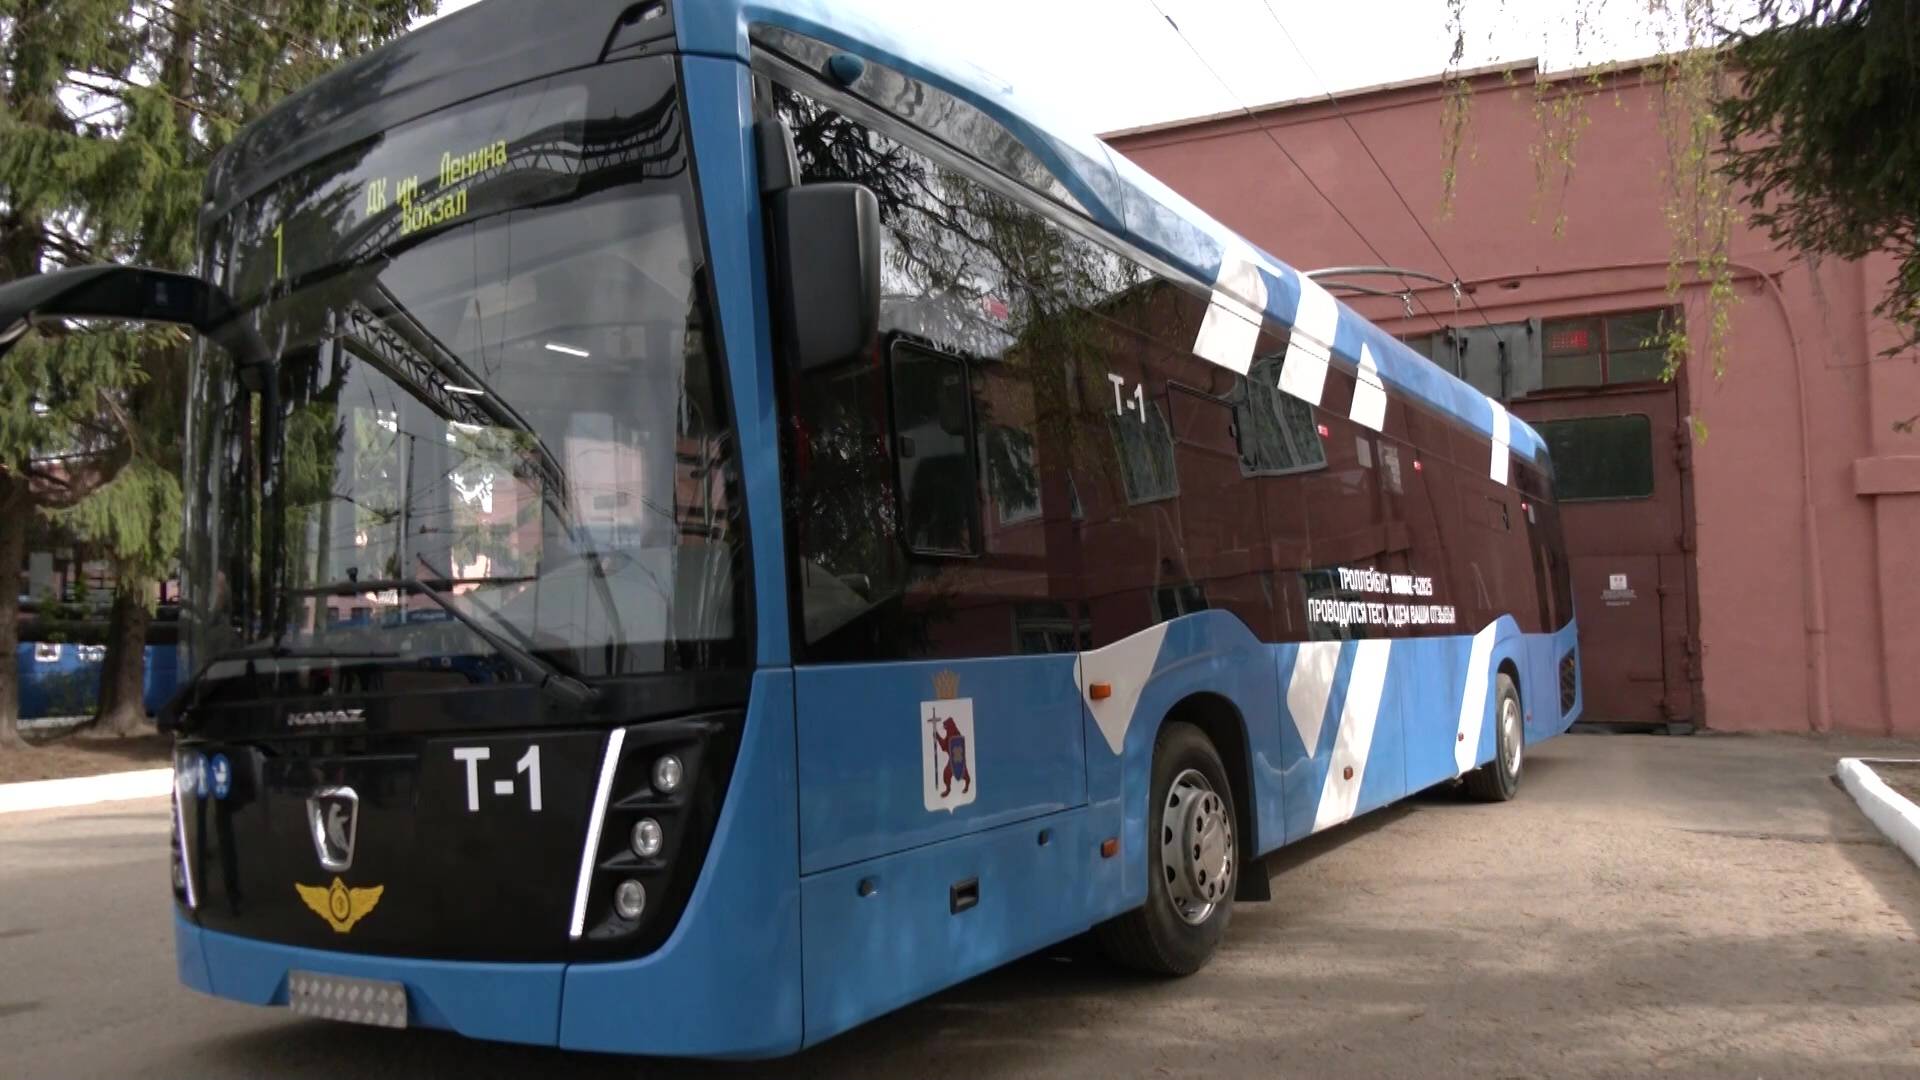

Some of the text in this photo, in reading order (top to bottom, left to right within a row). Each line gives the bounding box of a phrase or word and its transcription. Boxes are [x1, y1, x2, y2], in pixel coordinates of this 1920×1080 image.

[366, 140, 508, 217] ДК им. Ленина
[400, 187, 467, 235] Вокзал
[272, 221, 286, 280] 1
[1338, 566, 1389, 593] ТРОЛЛЕЙБУС
[1307, 598, 1367, 627] ПРОВОДИТСЯ
[1366, 602, 1388, 627] ТЕСТ,
[1409, 605, 1430, 624] ВАШИ
